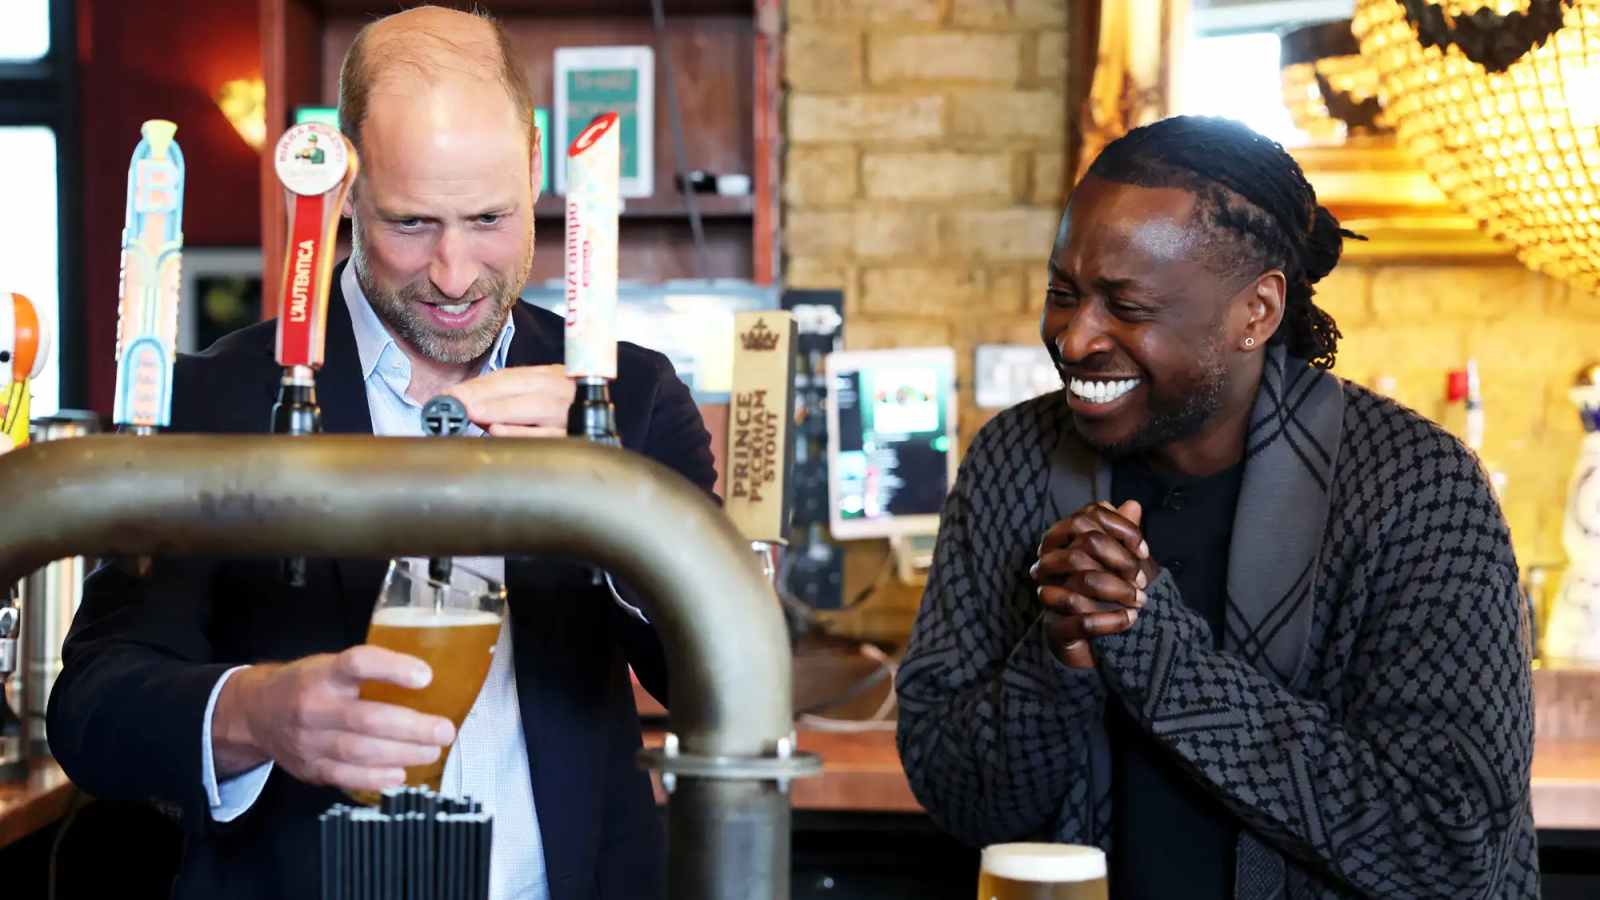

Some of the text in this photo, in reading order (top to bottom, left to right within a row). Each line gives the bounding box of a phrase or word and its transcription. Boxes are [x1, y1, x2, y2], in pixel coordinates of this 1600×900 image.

[290, 239, 315, 322] L'AUTENTICA
[732, 391, 752, 497] PRINCE
[750, 389, 767, 502] PECKHAM
[764, 411, 777, 482] STOUT
